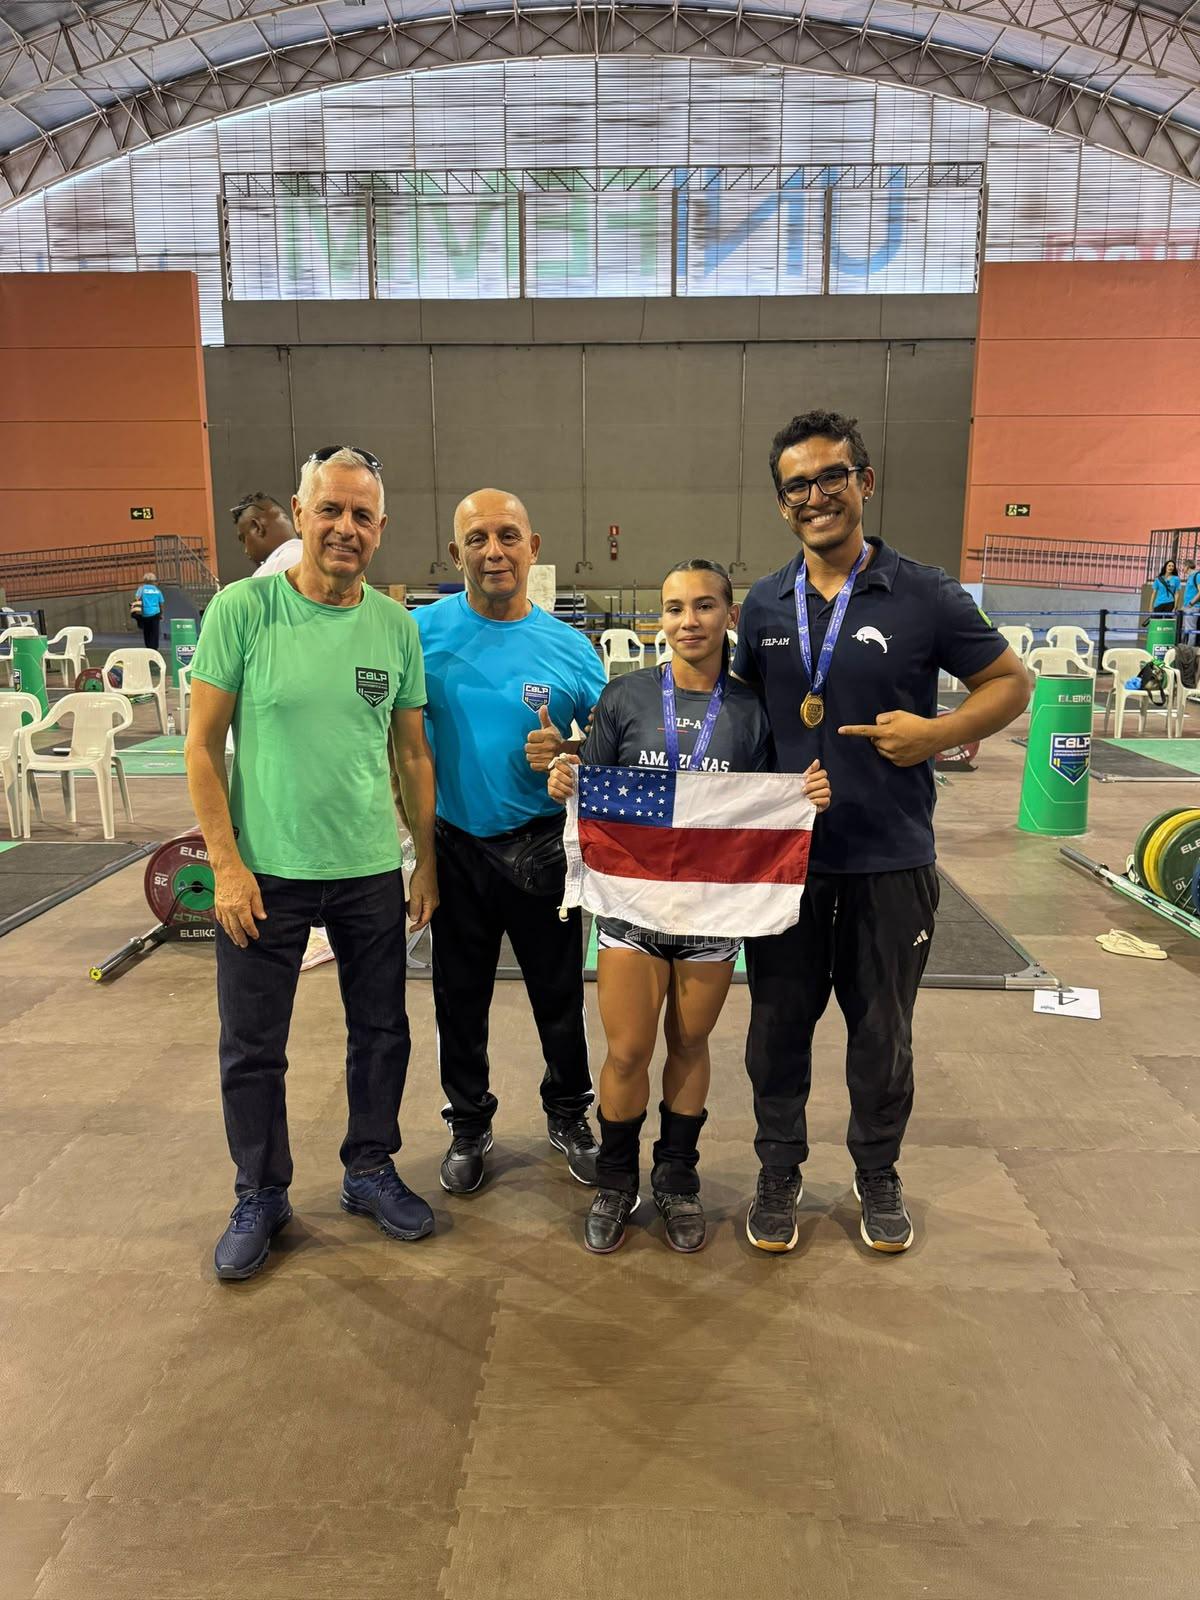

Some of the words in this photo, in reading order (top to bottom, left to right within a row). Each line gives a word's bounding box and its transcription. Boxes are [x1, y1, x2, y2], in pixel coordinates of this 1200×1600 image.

[358, 670, 388, 682] CBLP
[525, 684, 549, 693] CBLP
[1058, 694, 1092, 703] ELEIKO
[1054, 736, 1091, 749] CBLP
[638, 750, 731, 774] AMZNAS
[180, 846, 210, 861] ELEI
[153, 876, 169, 886] 25
